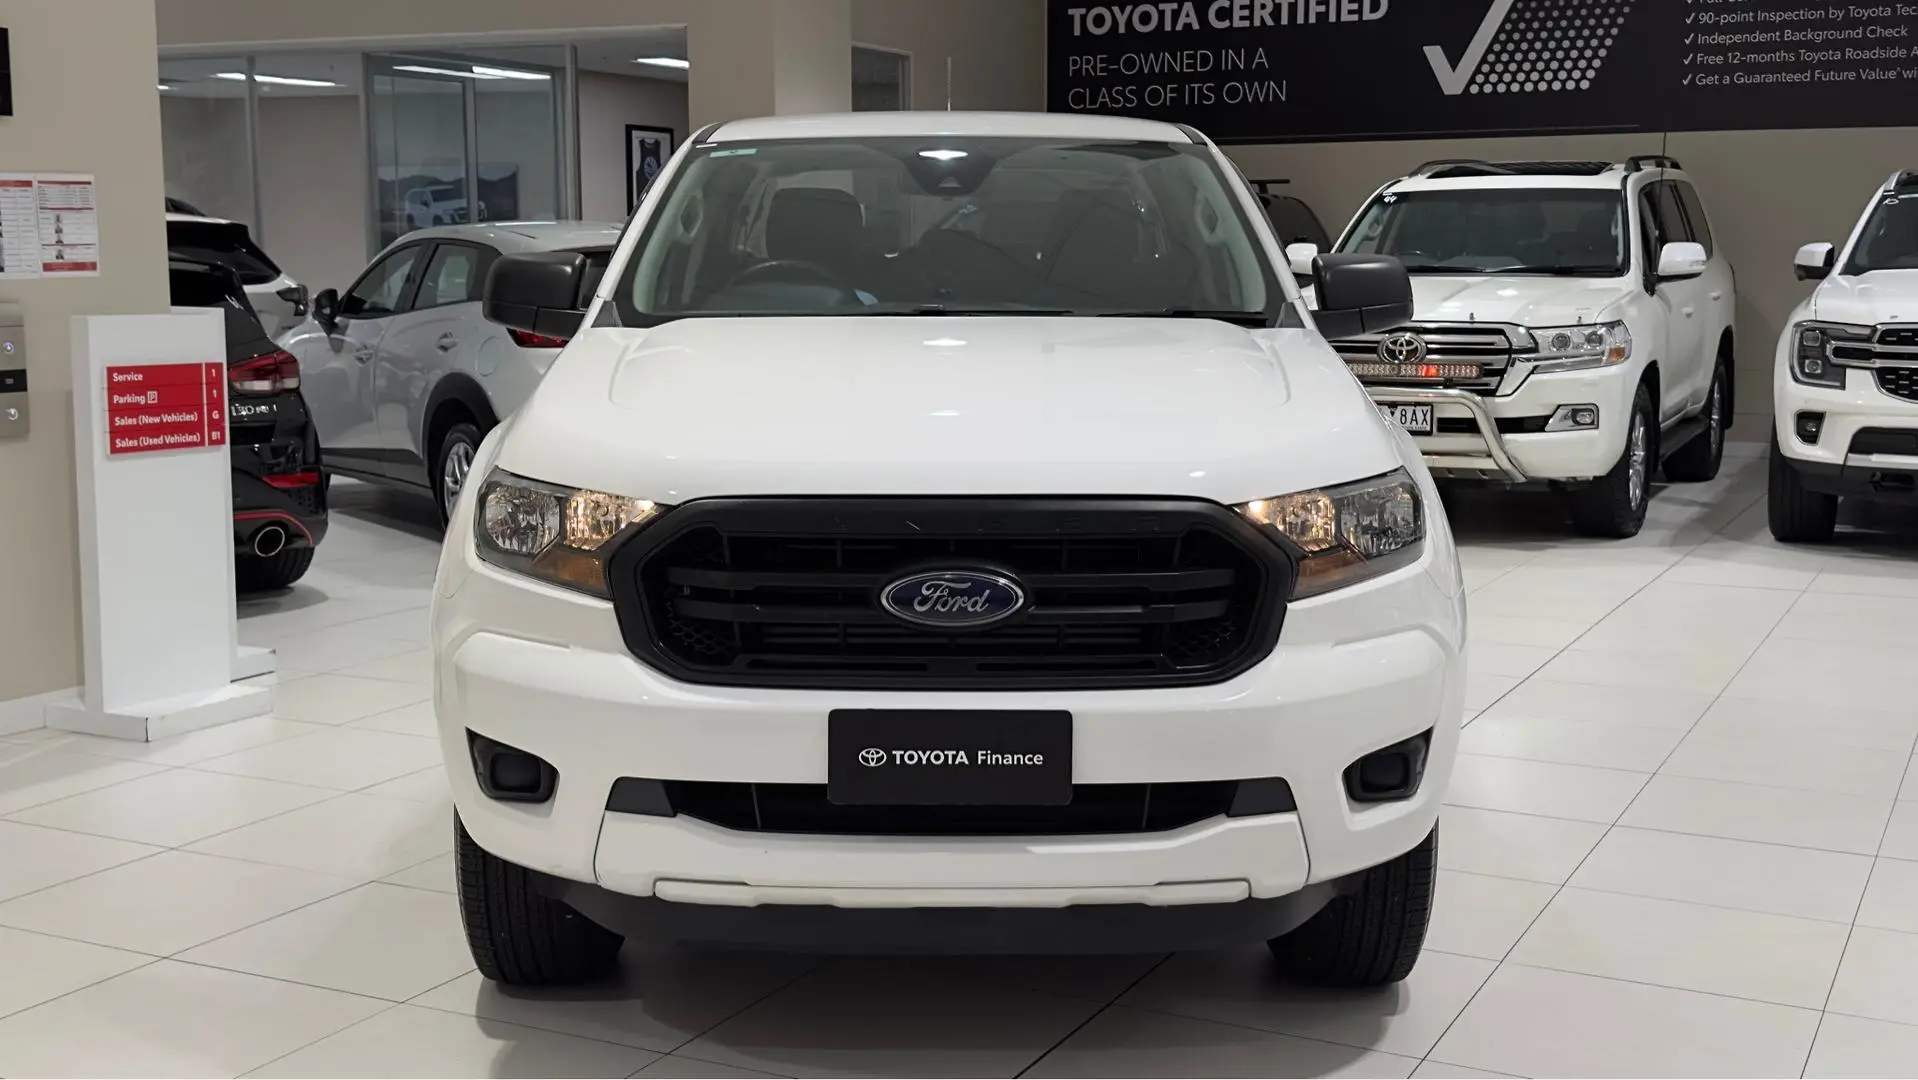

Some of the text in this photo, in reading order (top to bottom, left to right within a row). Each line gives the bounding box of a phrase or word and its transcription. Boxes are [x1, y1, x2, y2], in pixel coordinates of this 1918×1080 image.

[1068, 0, 1389, 36] TOYOTA CERTIFIED
[1698, 11, 1754, 25] 90-point
[1757, 8, 1825, 23] Inspection
[1828, 6, 1845, 21] by
[1848, 5, 1891, 20] Toyota
[1697, 25, 1908, 46] Independent Background Check
[1069, 47, 1269, 77] PRE-OWNED IN A
[1697, 53, 1724, 65] Free
[1727, 50, 1795, 64] 12-months
[1798, 47, 1841, 63] Toyota
[1845, 46, 1907, 60] Roadside
[1695, 73, 1720, 85] Get
[1722, 75, 1730, 84] a
[1733, 69, 1811, 84] Guaranteed
[1814, 69, 1857, 81] Future
[1068, 80, 1287, 109] CLASS OF ITS OWN
[112, 368, 217, 383] Service 1
[112, 394, 146, 405] Parking
[212, 389, 218, 399] 1
[114, 410, 220, 427] Sales (New Vehicles) G
[115, 431, 221, 449] Sales (Used Vehicles) B1
[913, 581, 990, 612] Ford
[892, 750, 1044, 765] TOYOTA Finance
